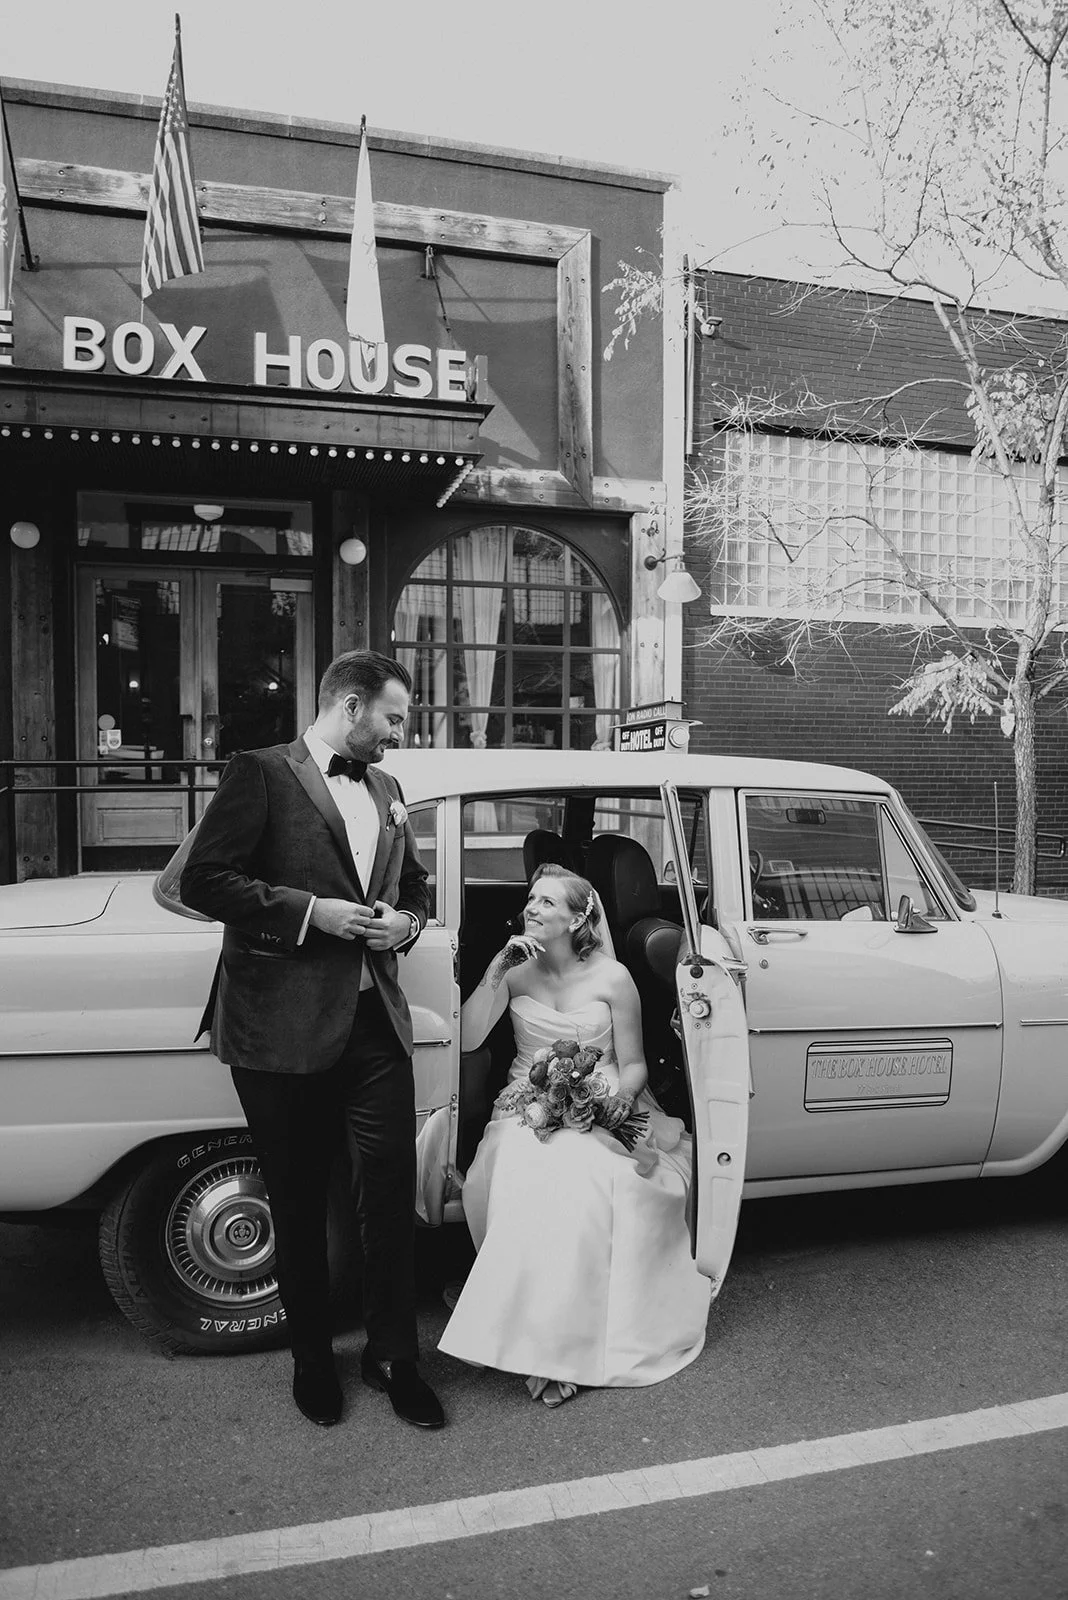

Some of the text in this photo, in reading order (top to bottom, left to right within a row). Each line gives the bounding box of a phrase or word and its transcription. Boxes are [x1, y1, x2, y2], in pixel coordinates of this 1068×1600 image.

[62, 315, 208, 383] BOX
[253, 331, 467, 401] HOUSE
[636, 709, 652, 719] RADIO
[654, 707, 665, 716] CALL
[622, 731, 630, 740] OFF
[630, 729, 652, 750] HOTEL
[655, 726, 664, 736] OFF
[653, 738, 664, 748] DUTY
[811, 1054, 947, 1079] THE BOX HOUSE HOTEL
[177, 1134, 253, 1168] GENER
[199, 1308, 287, 1332] ENERAL
